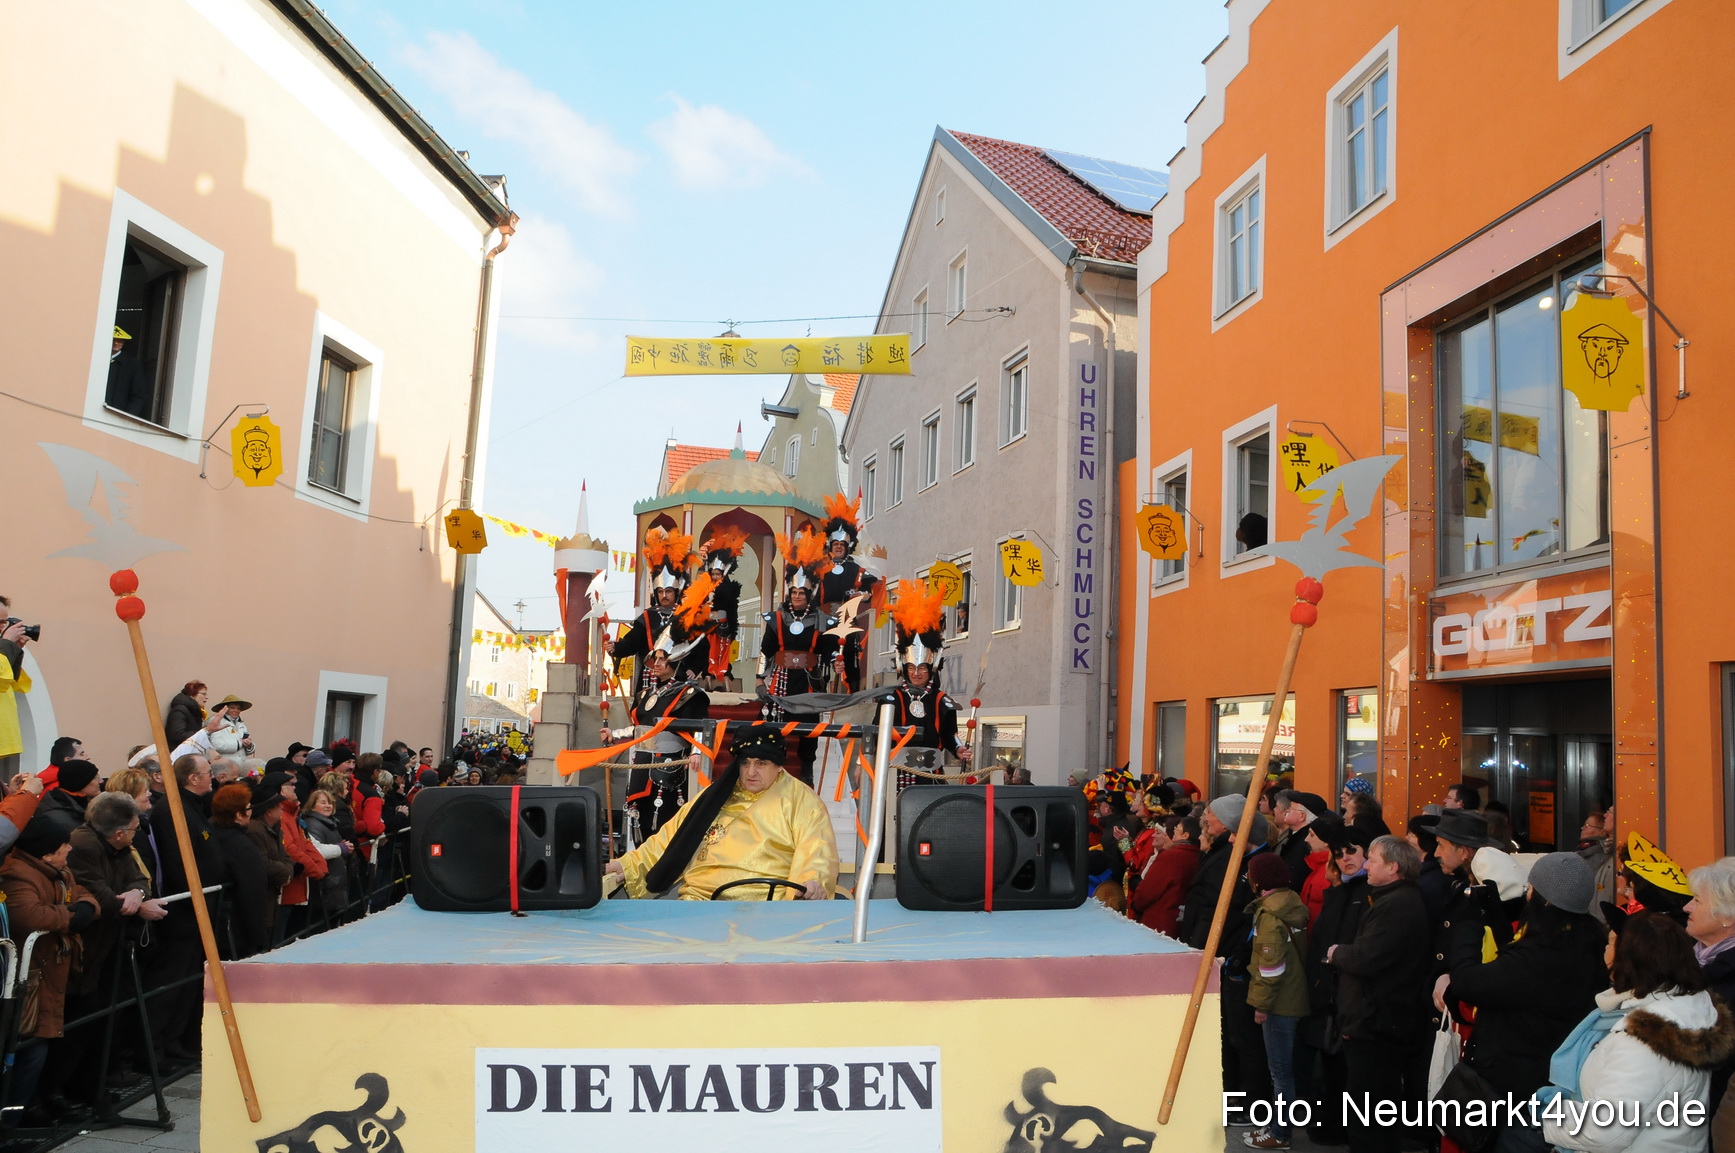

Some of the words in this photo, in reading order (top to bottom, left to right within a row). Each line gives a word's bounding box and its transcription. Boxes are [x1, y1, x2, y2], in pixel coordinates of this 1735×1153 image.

[1079, 364, 1097, 480] UHREN
[1073, 499, 1094, 669] SCHMUCK
[487, 1064, 612, 1112] DIE
[629, 1061, 937, 1113] MAUREN
